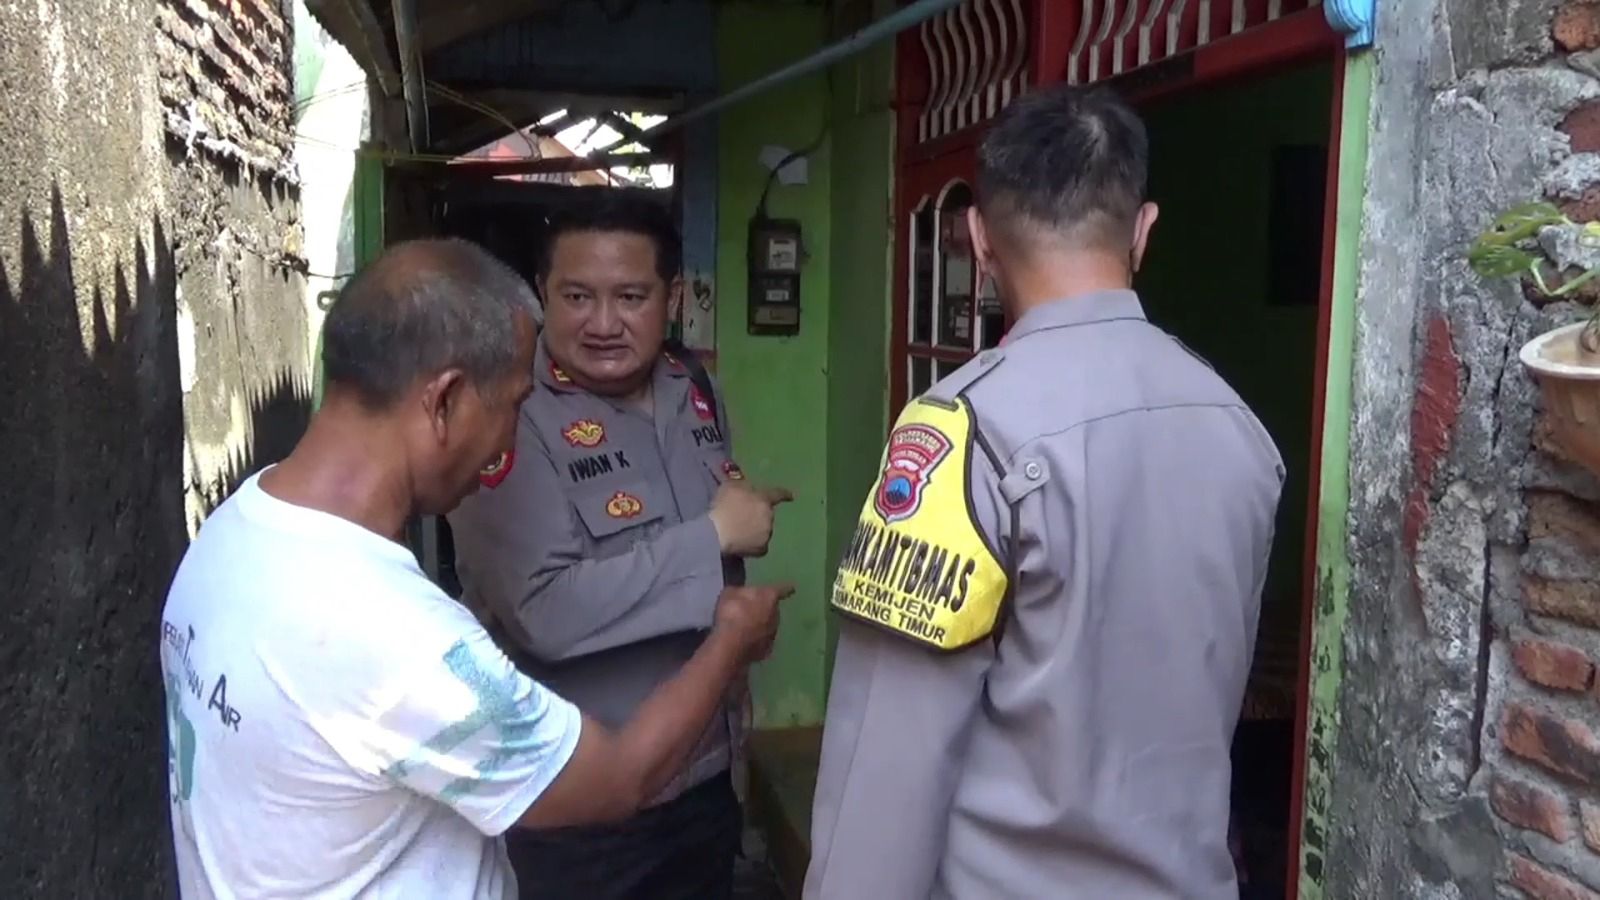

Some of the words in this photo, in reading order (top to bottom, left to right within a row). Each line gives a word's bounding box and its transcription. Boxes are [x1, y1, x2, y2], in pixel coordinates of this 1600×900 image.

[567, 454, 613, 483] IWAN
[614, 450, 631, 469] K
[853, 579, 936, 622] KEMIJEN
[898, 612, 946, 643] TIMUR
